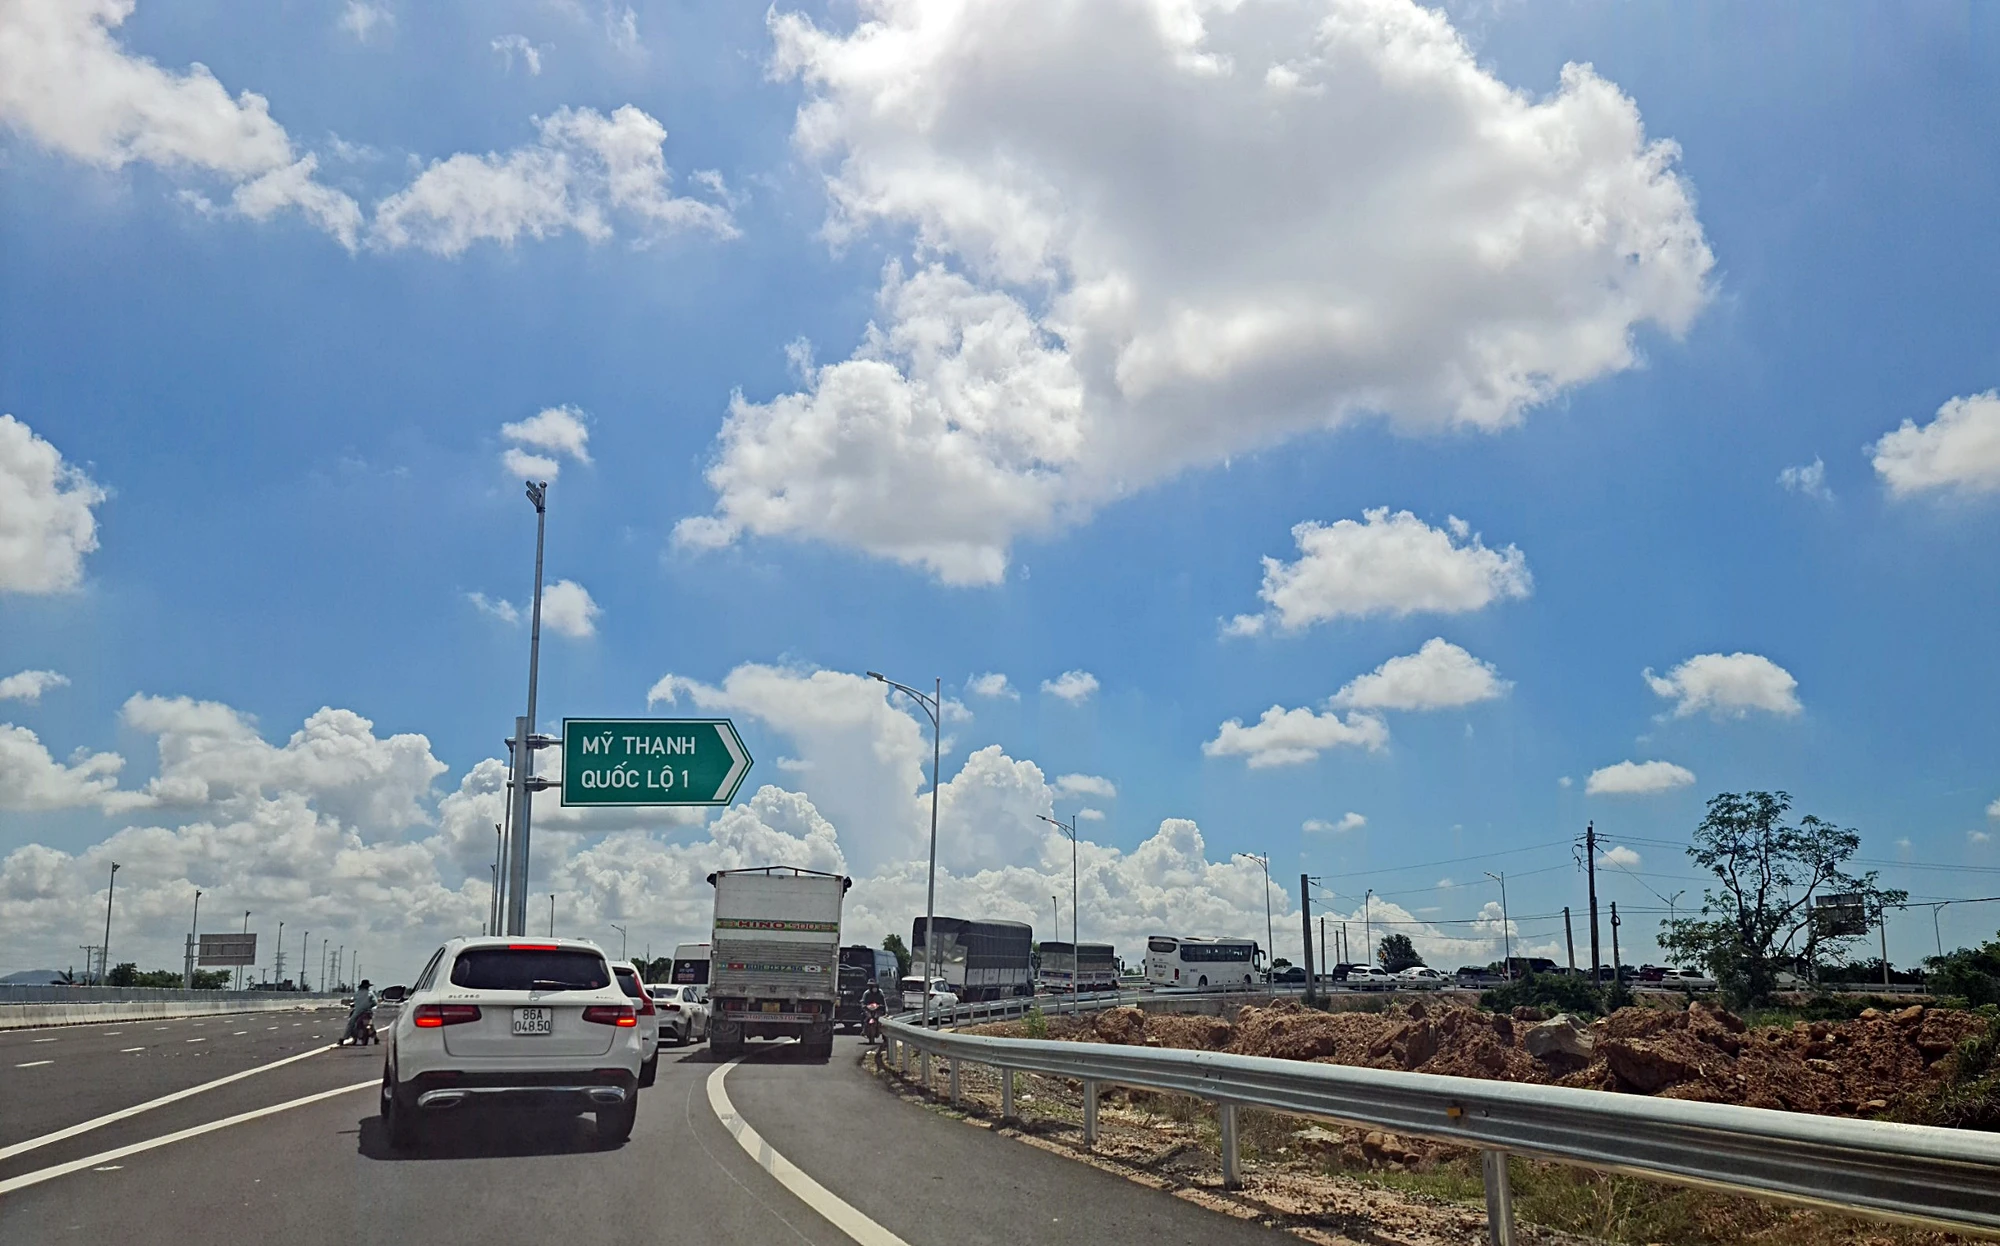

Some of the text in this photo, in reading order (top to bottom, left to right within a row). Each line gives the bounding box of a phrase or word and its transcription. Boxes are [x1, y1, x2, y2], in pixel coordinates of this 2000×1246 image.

[582, 730, 696, 758] MỸ THẠNH
[581, 761, 689, 792] QUỐC LỘ 1
[738, 920, 786, 930] HINO
[522, 1009, 543, 1020] 86A
[514, 1020, 551, 1032] 048.50
